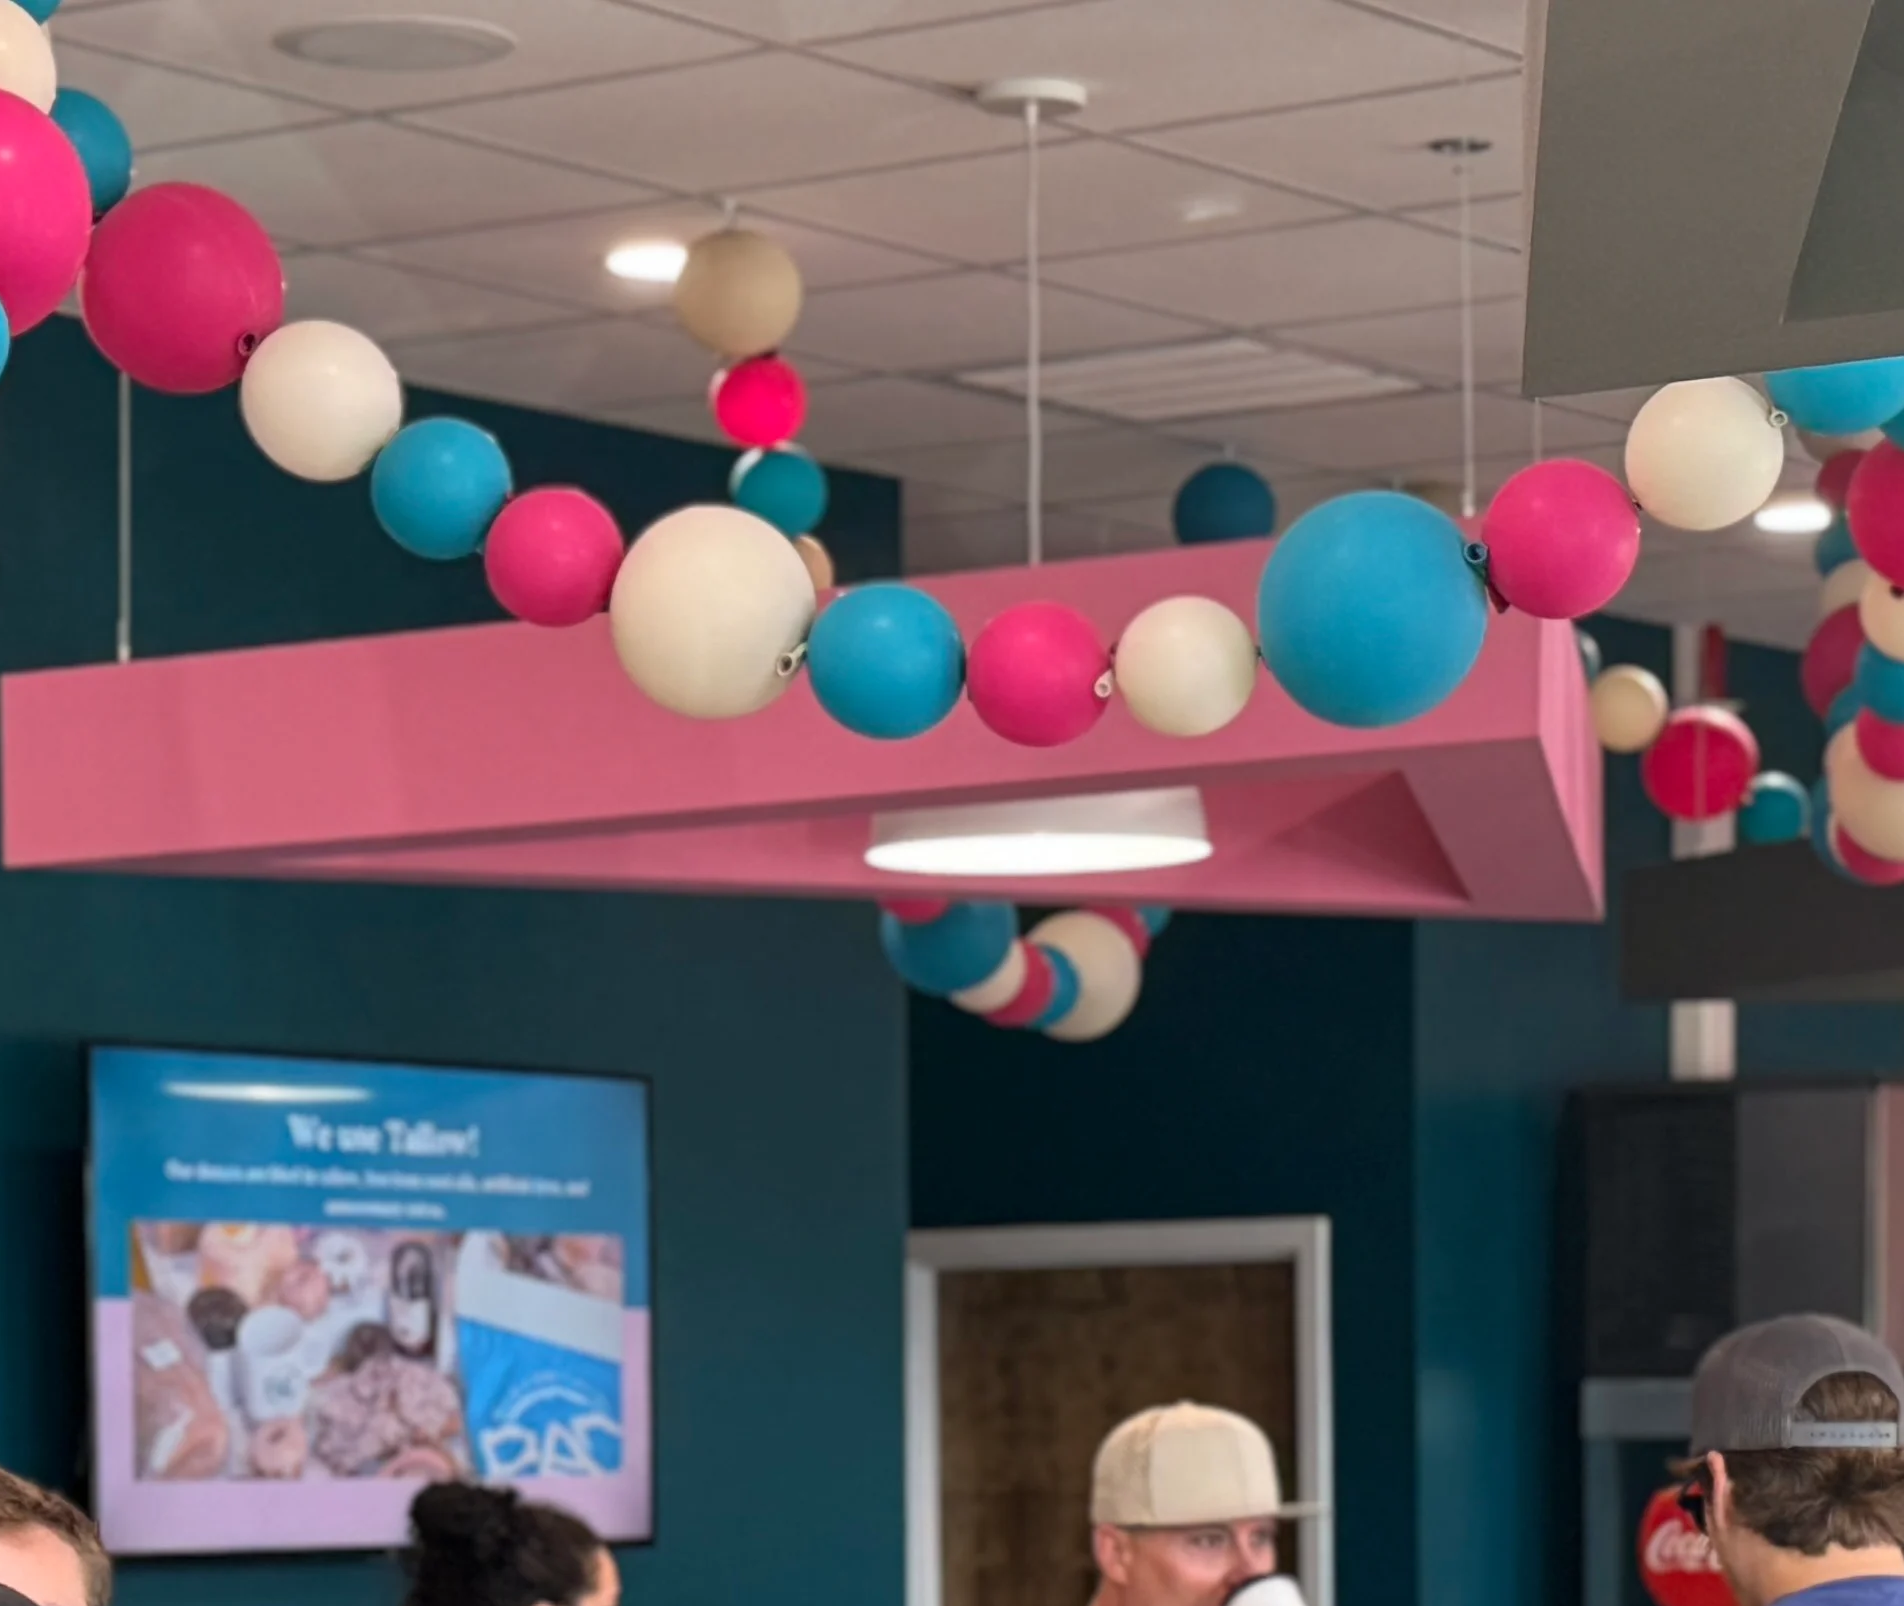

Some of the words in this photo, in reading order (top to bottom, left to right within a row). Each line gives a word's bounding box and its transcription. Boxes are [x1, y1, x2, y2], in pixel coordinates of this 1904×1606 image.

[287, 1113, 334, 1152] We
[337, 1125, 382, 1153] use
[383, 1117, 481, 1158] Tallow!
